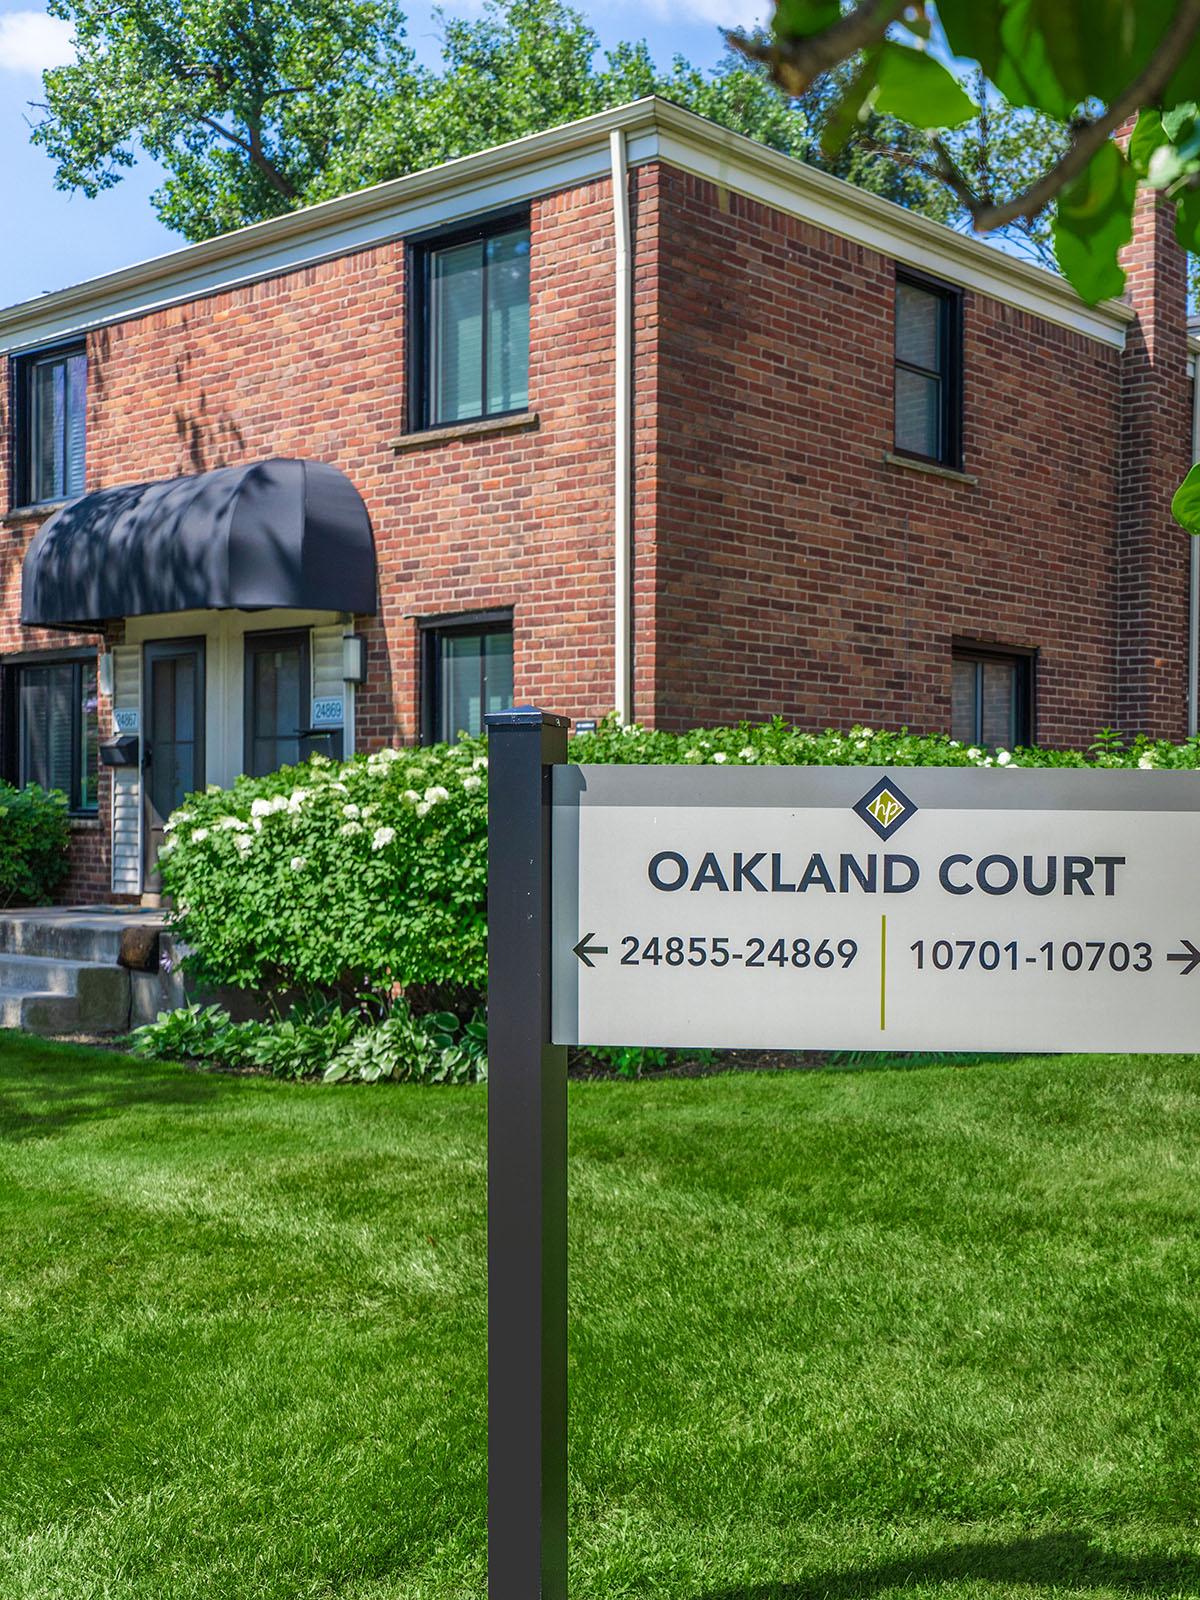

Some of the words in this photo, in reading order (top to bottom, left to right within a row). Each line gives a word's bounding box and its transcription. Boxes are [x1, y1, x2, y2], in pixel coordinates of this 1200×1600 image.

[647, 851, 920, 894] OAKLAND
[938, 853, 1126, 897] COURT
[620, 935, 858, 969] 24855-24869
[910, 939, 1153, 973] 10701-10703
